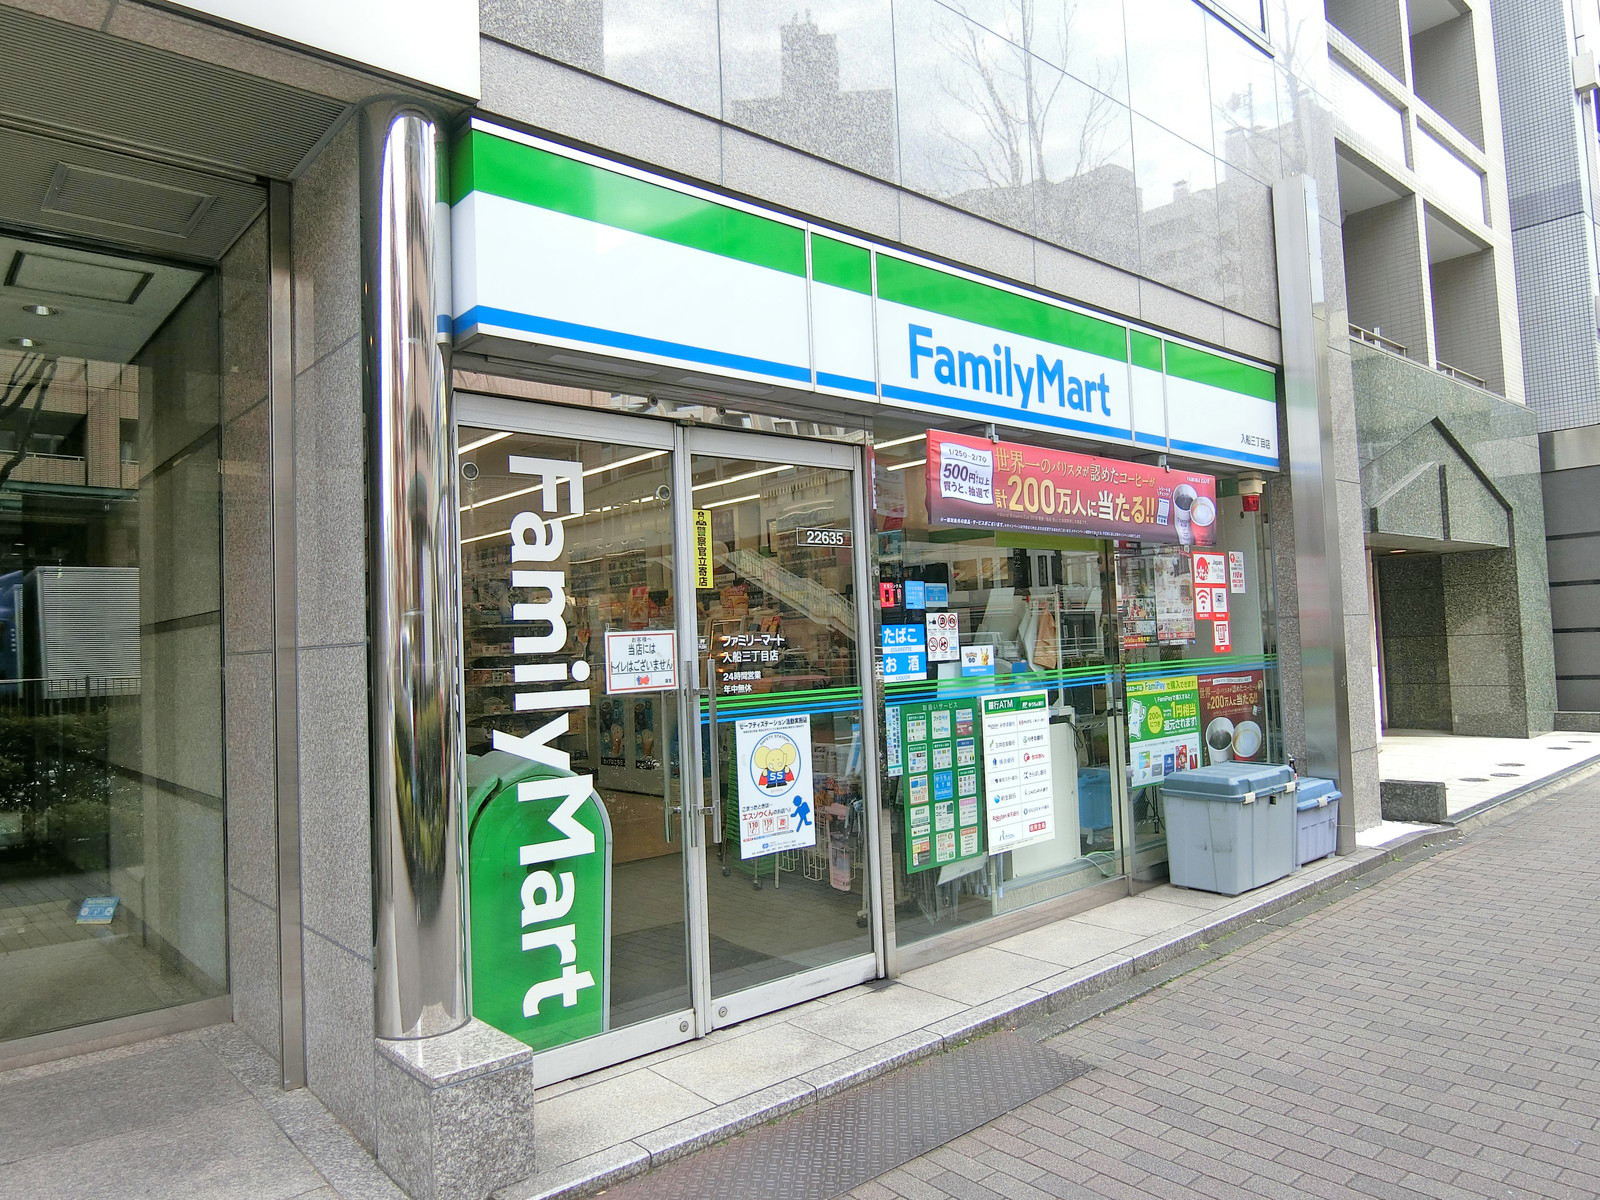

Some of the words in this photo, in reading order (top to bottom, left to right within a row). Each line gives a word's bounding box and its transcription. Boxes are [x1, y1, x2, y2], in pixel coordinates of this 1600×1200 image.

[909, 323, 1111, 417] FamilyMart
[1240, 433, 1271, 450] 入船三丁目店
[806, 530, 844, 545] 22635
[721, 634, 785, 647] ファミリーマート
[883, 627, 918, 644] たばこ
[628, 643, 656, 656] 当店には
[722, 650, 779, 663] 入船三丁目店
[611, 659, 673, 673] トイレはございません
[885, 656, 897, 673] お
[908, 655, 920, 671] 酒
[722, 670, 762, 682] 24時間営業
[723, 684, 753, 694] 年中無休
[988, 699, 1014, 711] 銀行ATM
[492, 455, 597, 1018] FamilyMart
[769, 772, 784, 781] SS
